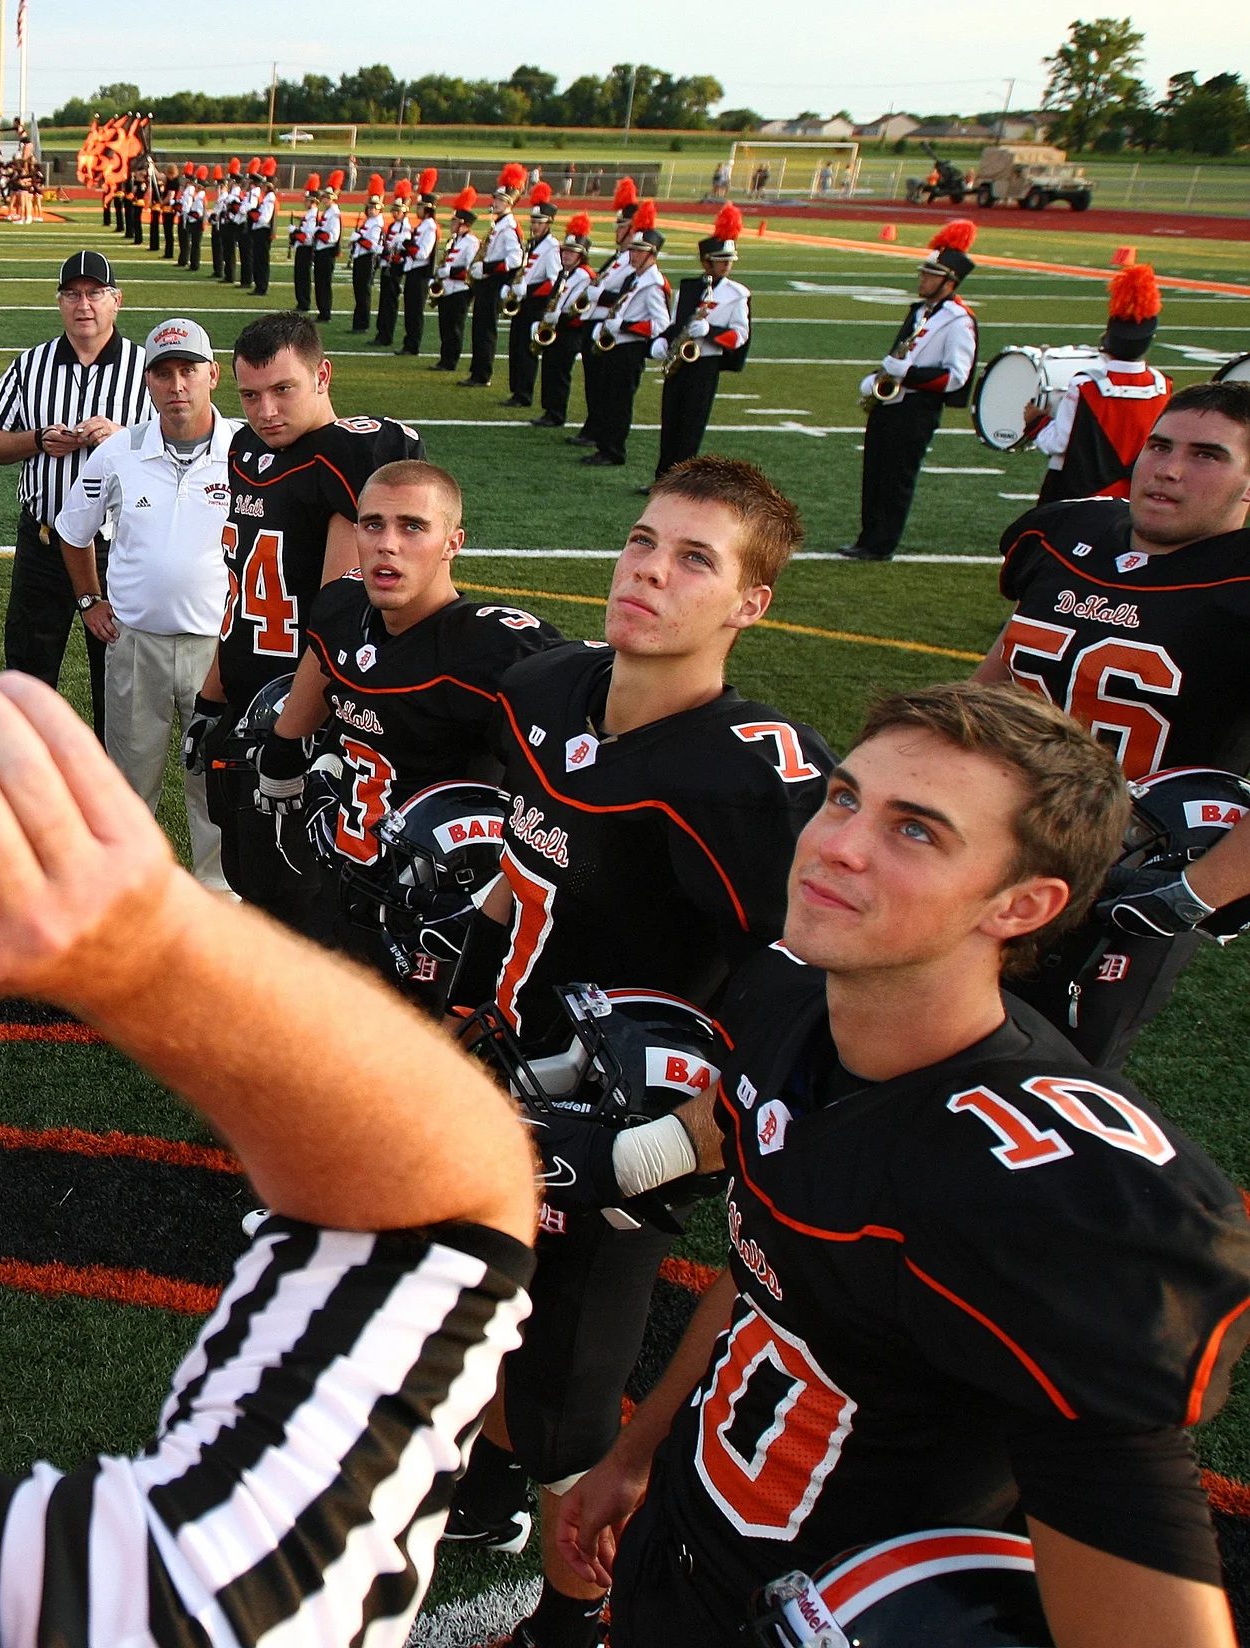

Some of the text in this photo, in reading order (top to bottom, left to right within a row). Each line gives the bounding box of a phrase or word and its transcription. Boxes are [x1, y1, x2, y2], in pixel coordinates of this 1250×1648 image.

[1054, 589, 1140, 629] DeKalb
[331, 695, 384, 735] DeKalb
[1001, 613, 1183, 782] 56
[730, 720, 822, 784] 7
[334, 733, 398, 868] 3
[508, 795, 570, 869] DeKalb
[945, 1075, 1177, 1171] 10
